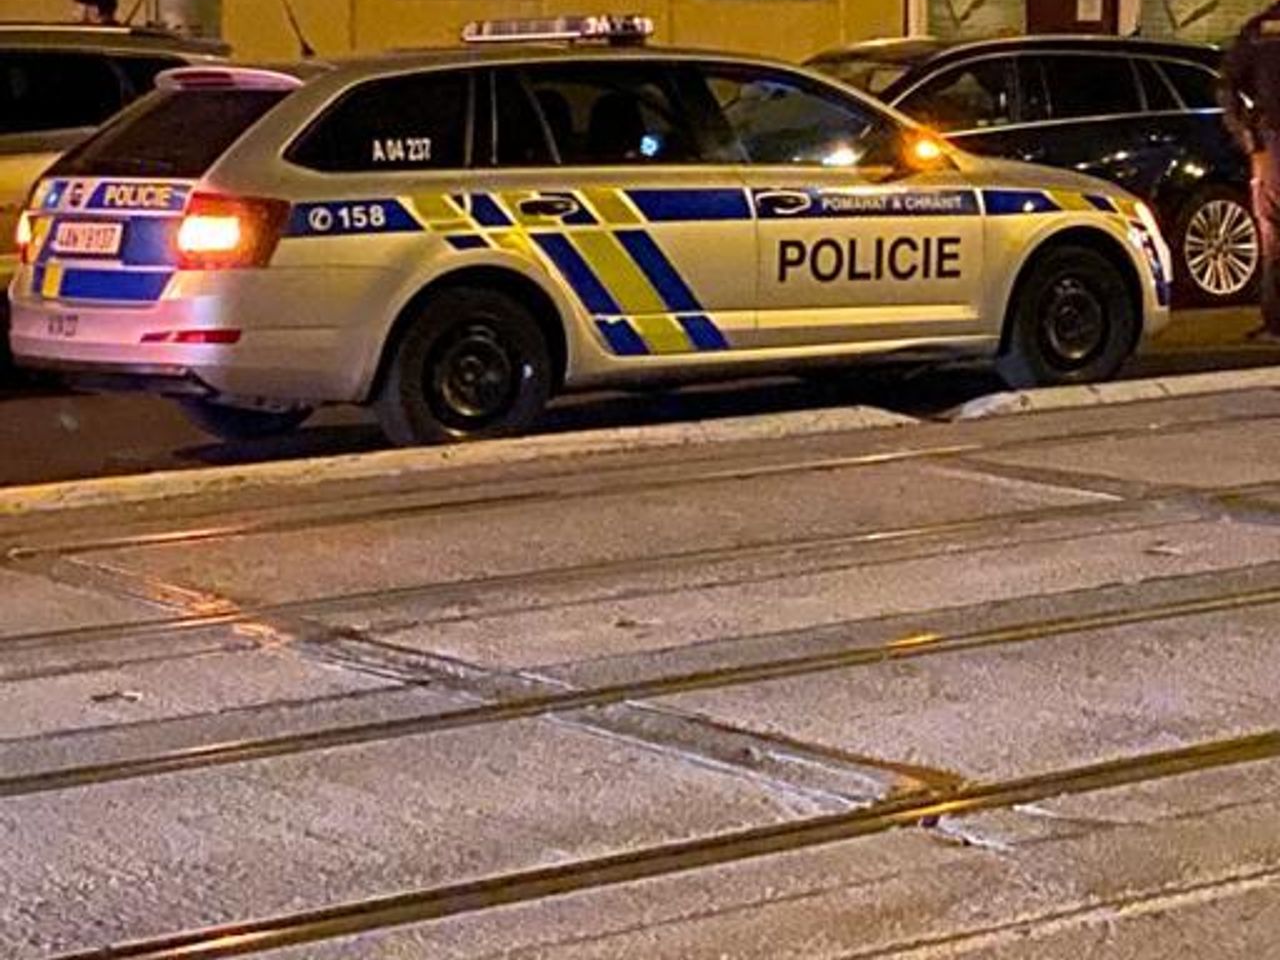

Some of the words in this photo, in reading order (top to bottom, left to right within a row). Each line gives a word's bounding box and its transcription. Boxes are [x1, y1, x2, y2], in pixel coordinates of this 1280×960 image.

[102, 184, 172, 208] POLICIE
[338, 204, 386, 228] 158
[777, 236, 963, 283] POLICIE
